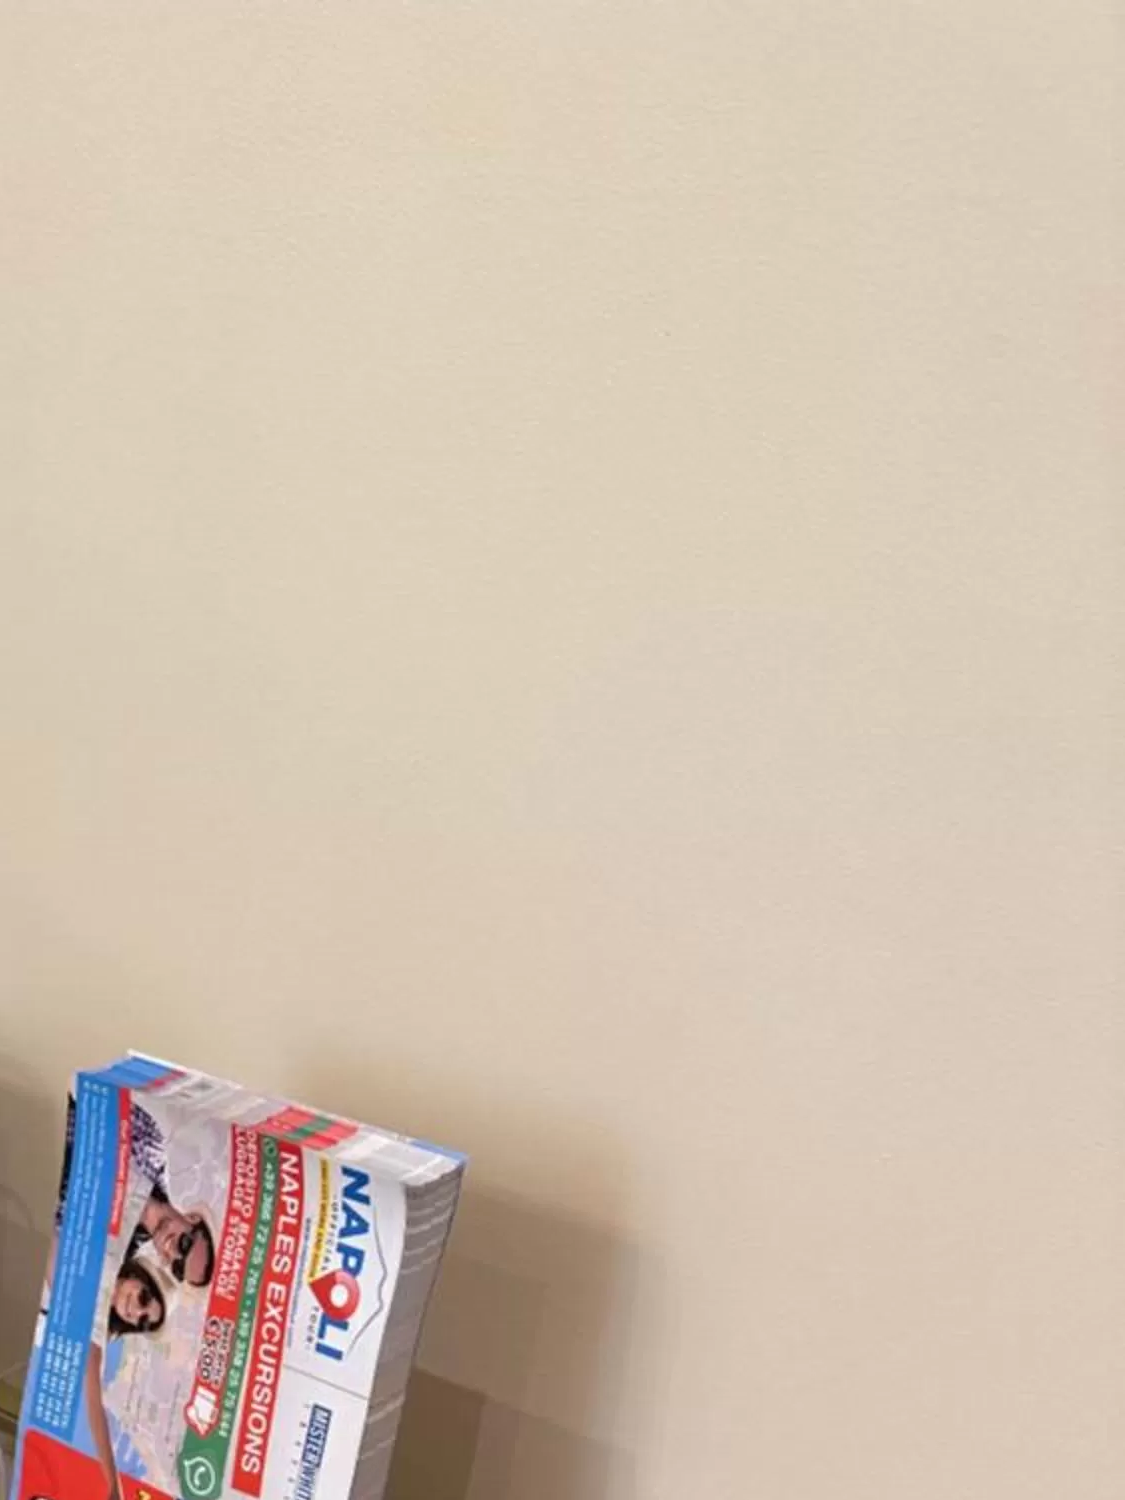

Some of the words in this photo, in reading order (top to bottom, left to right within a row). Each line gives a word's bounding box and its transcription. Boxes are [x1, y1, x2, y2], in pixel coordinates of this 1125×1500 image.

[231, 1126, 248, 1211] LUGGAGE
[271, 1151, 300, 1274] NAPLES
[215, 1215, 241, 1299] STORAGE
[309, 1164, 371, 1361] NAPOLI
[241, 1281, 287, 1472] EXCURSIONS
